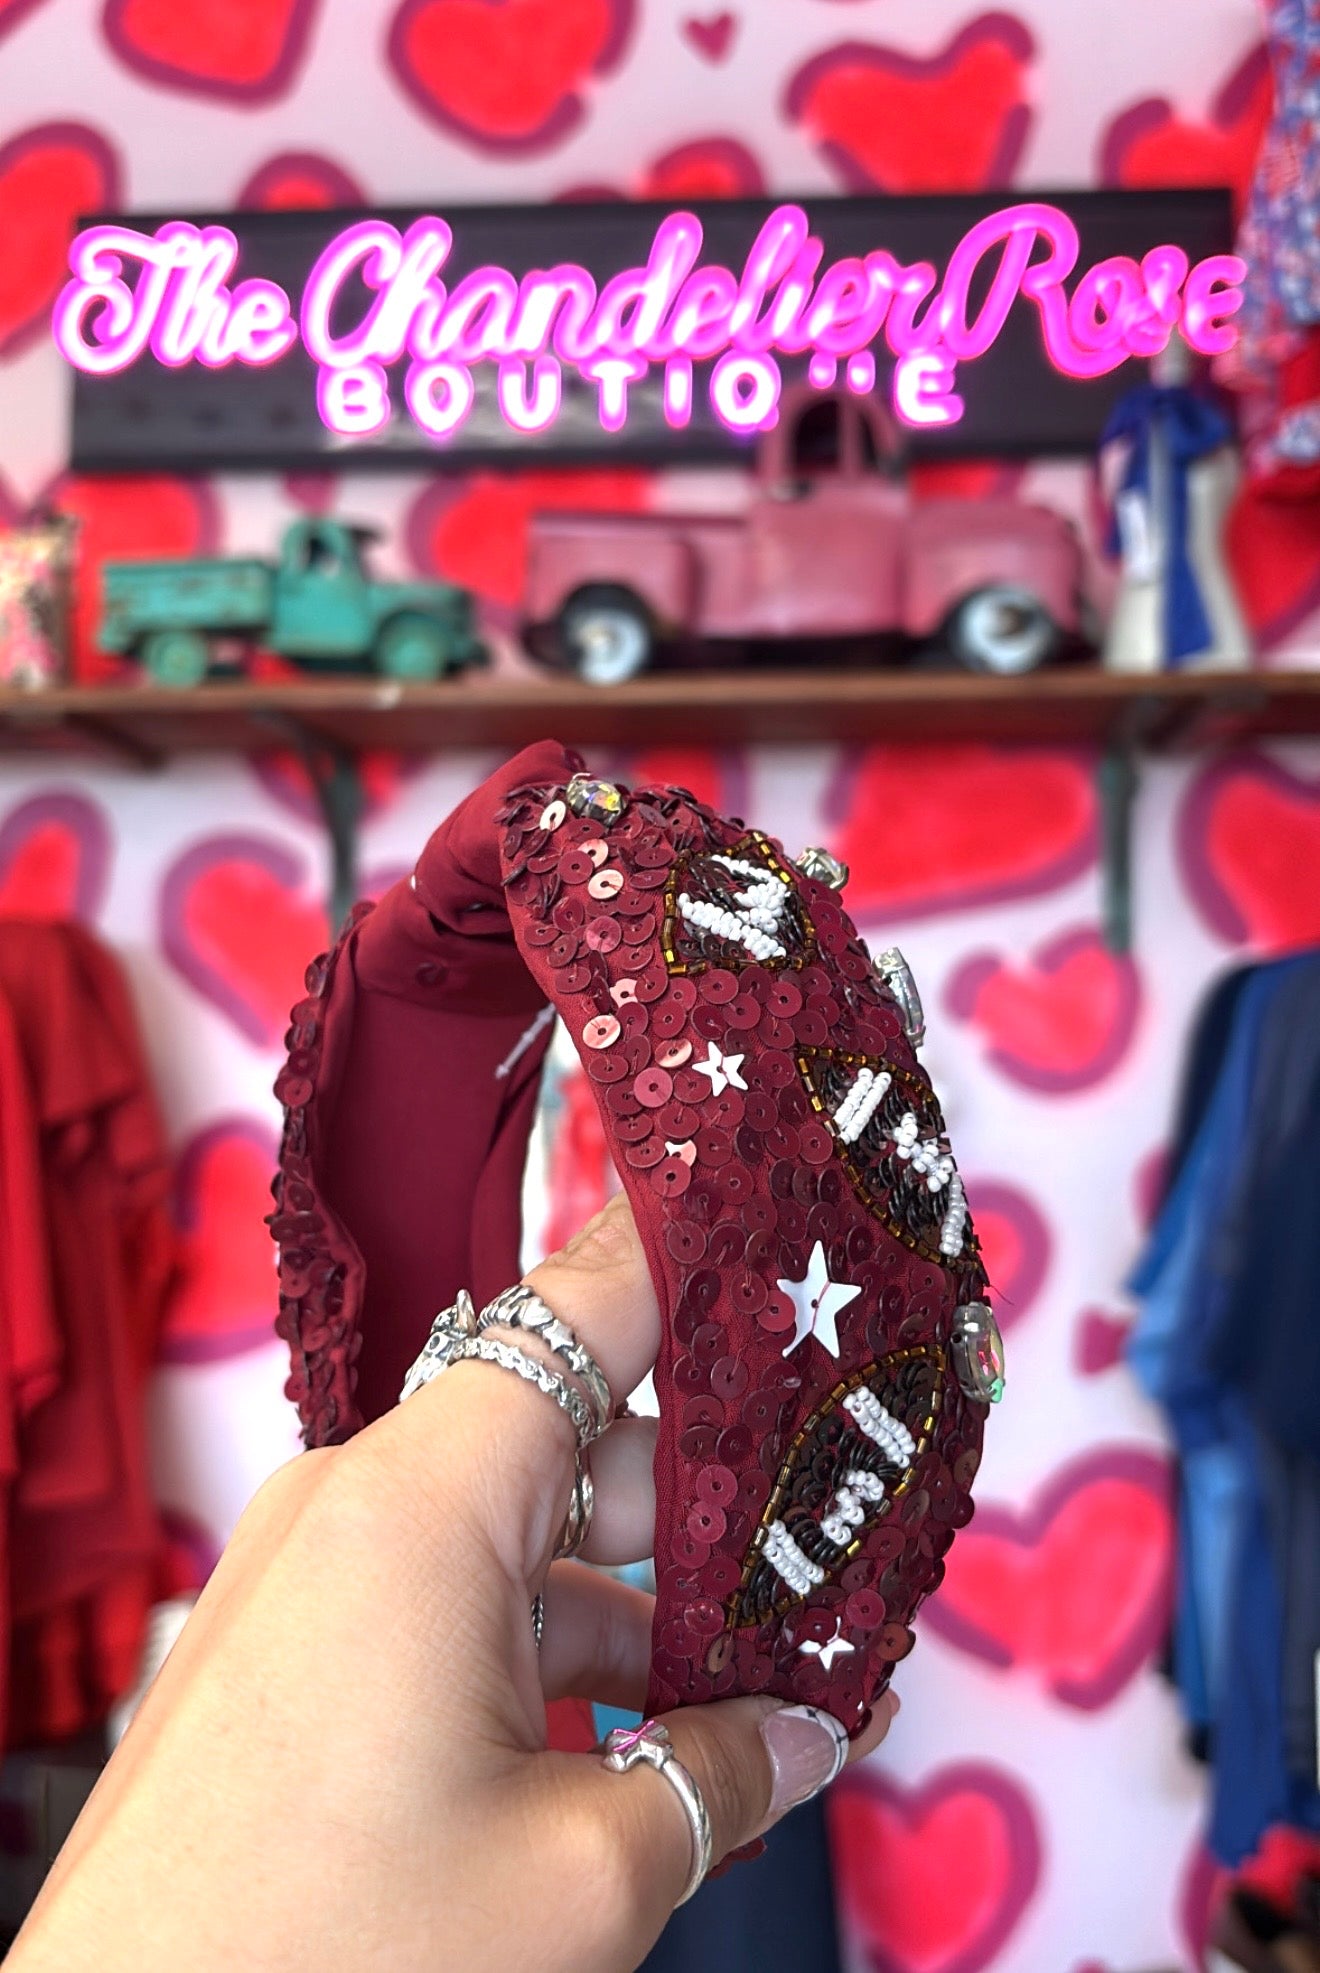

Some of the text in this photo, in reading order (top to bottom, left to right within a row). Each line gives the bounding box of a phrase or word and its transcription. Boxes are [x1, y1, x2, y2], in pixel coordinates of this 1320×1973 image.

[54, 203, 1247, 378] The Chandelier Rose
